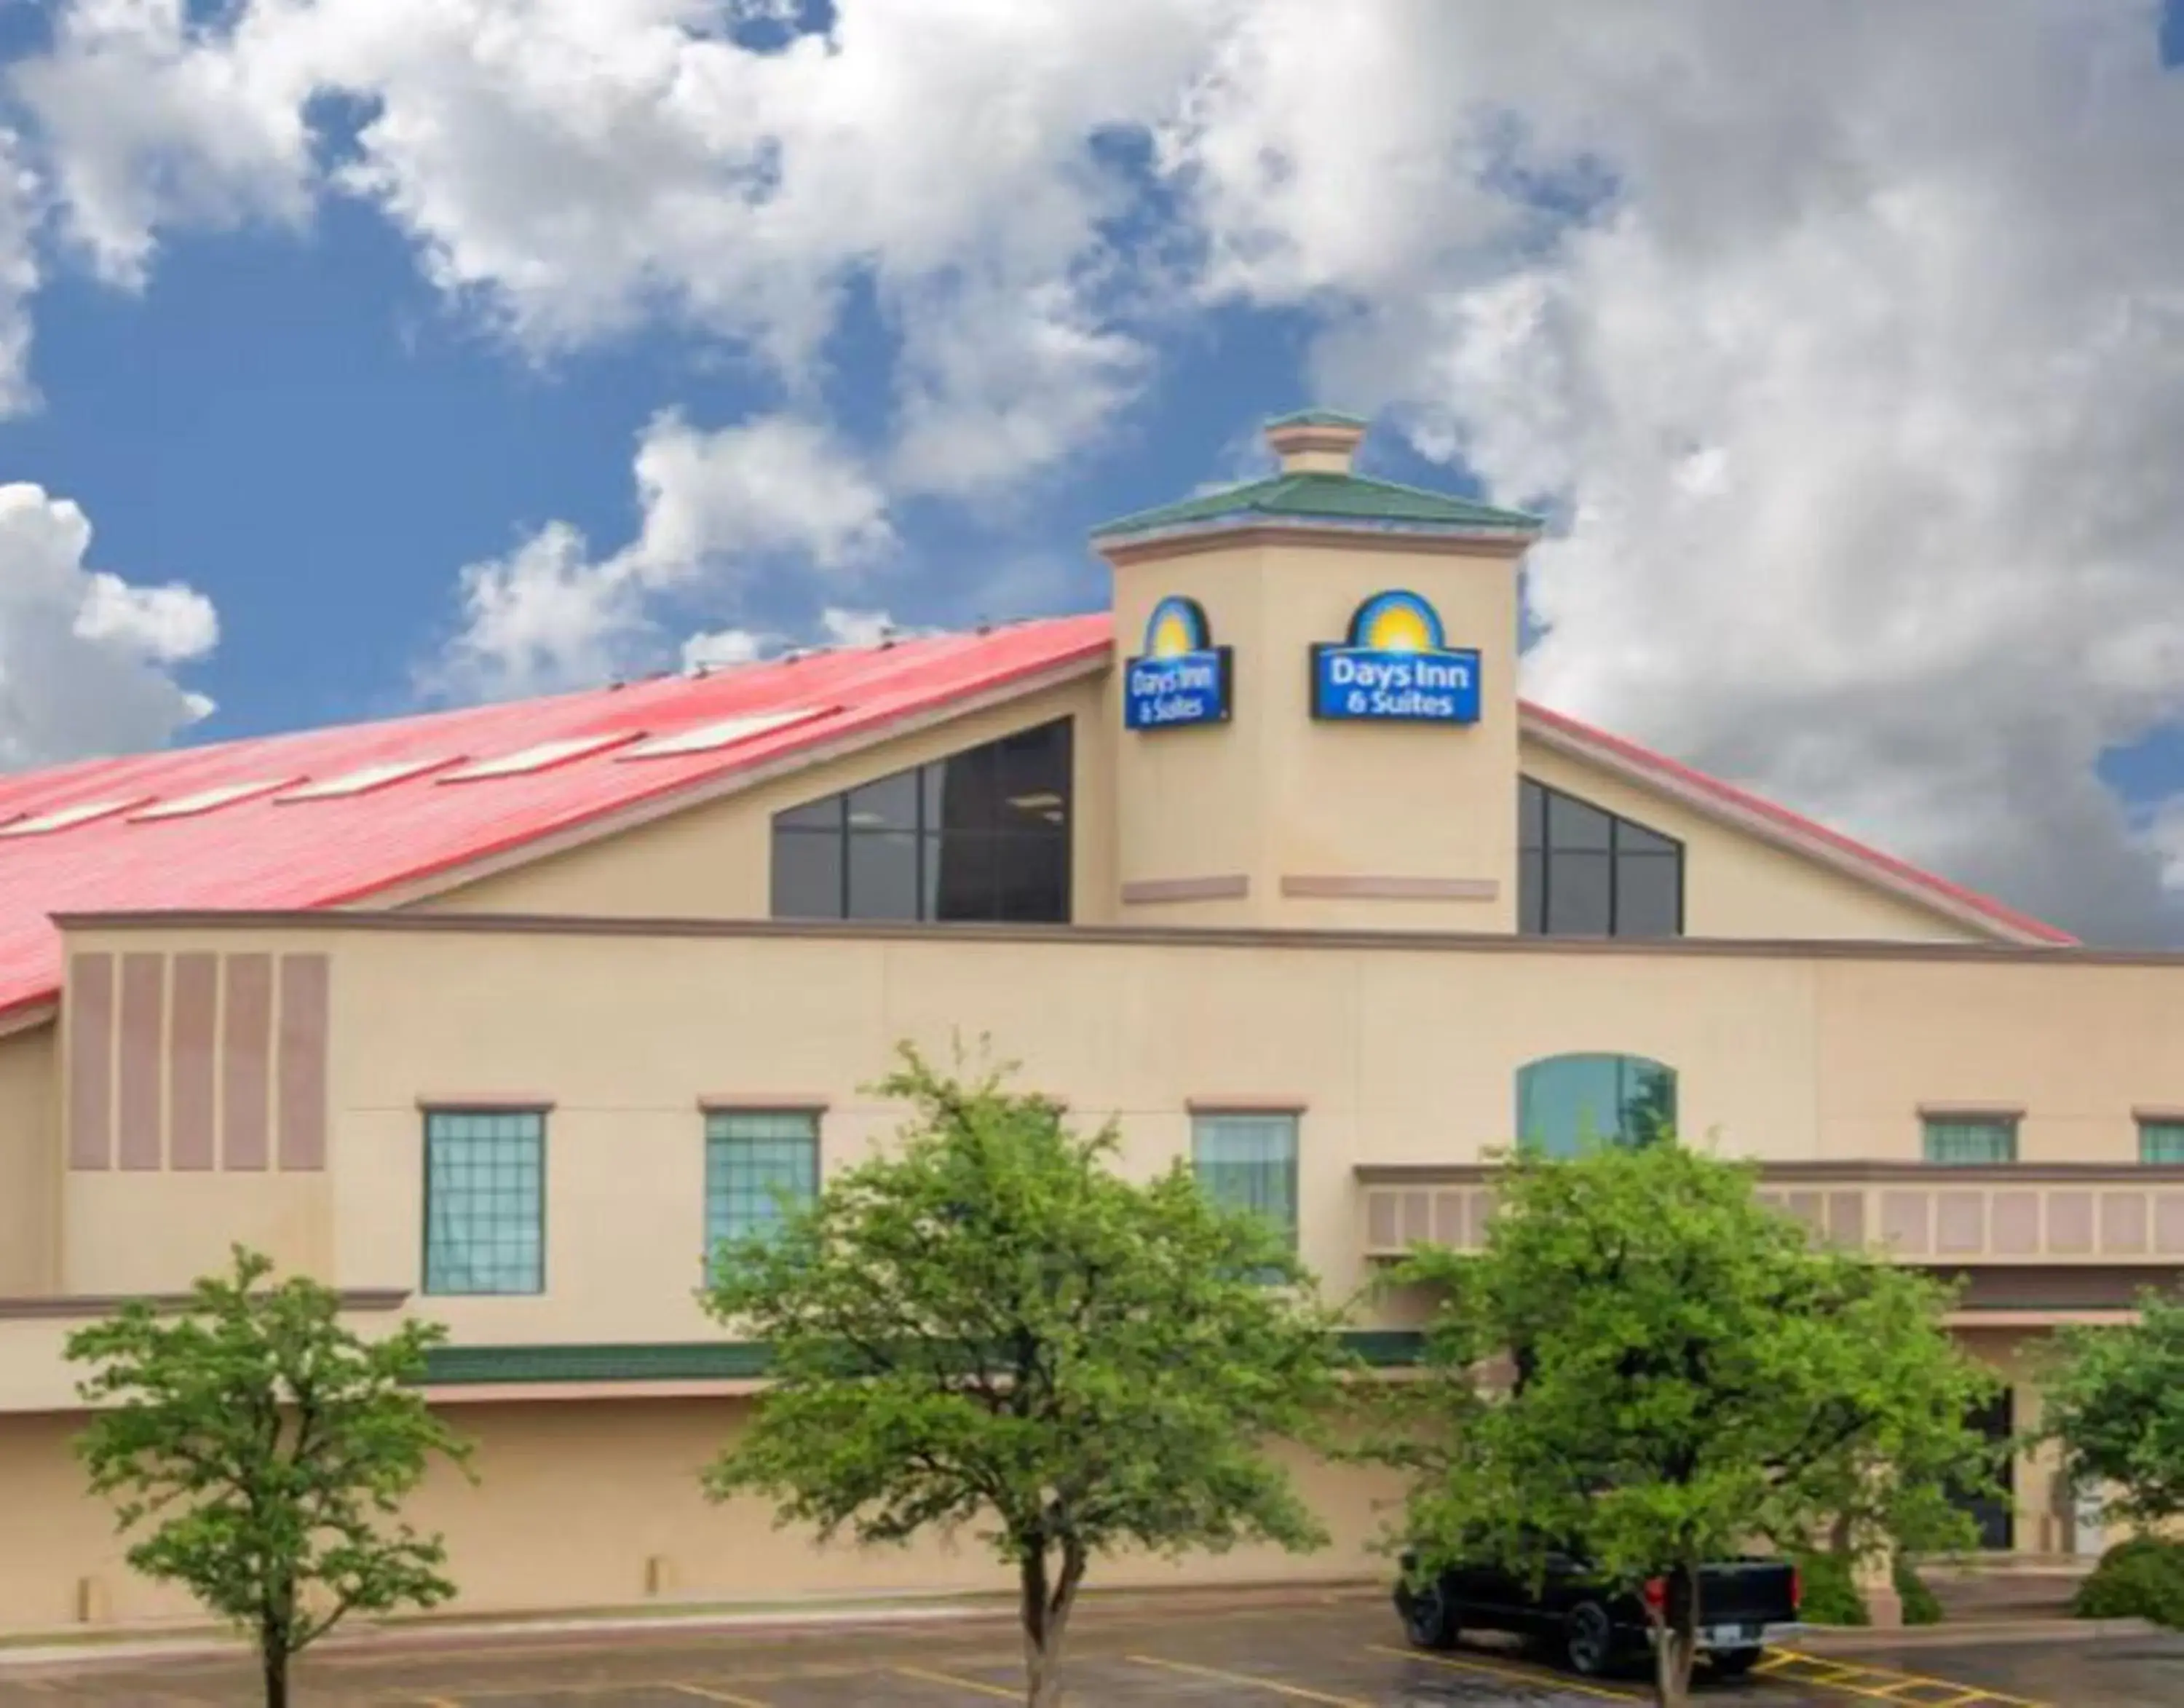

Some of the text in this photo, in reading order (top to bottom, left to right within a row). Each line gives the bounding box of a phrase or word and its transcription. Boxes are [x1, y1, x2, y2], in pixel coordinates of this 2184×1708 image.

[1330, 657, 1469, 690] Days Inn
[1348, 689, 1455, 716] & Suites
